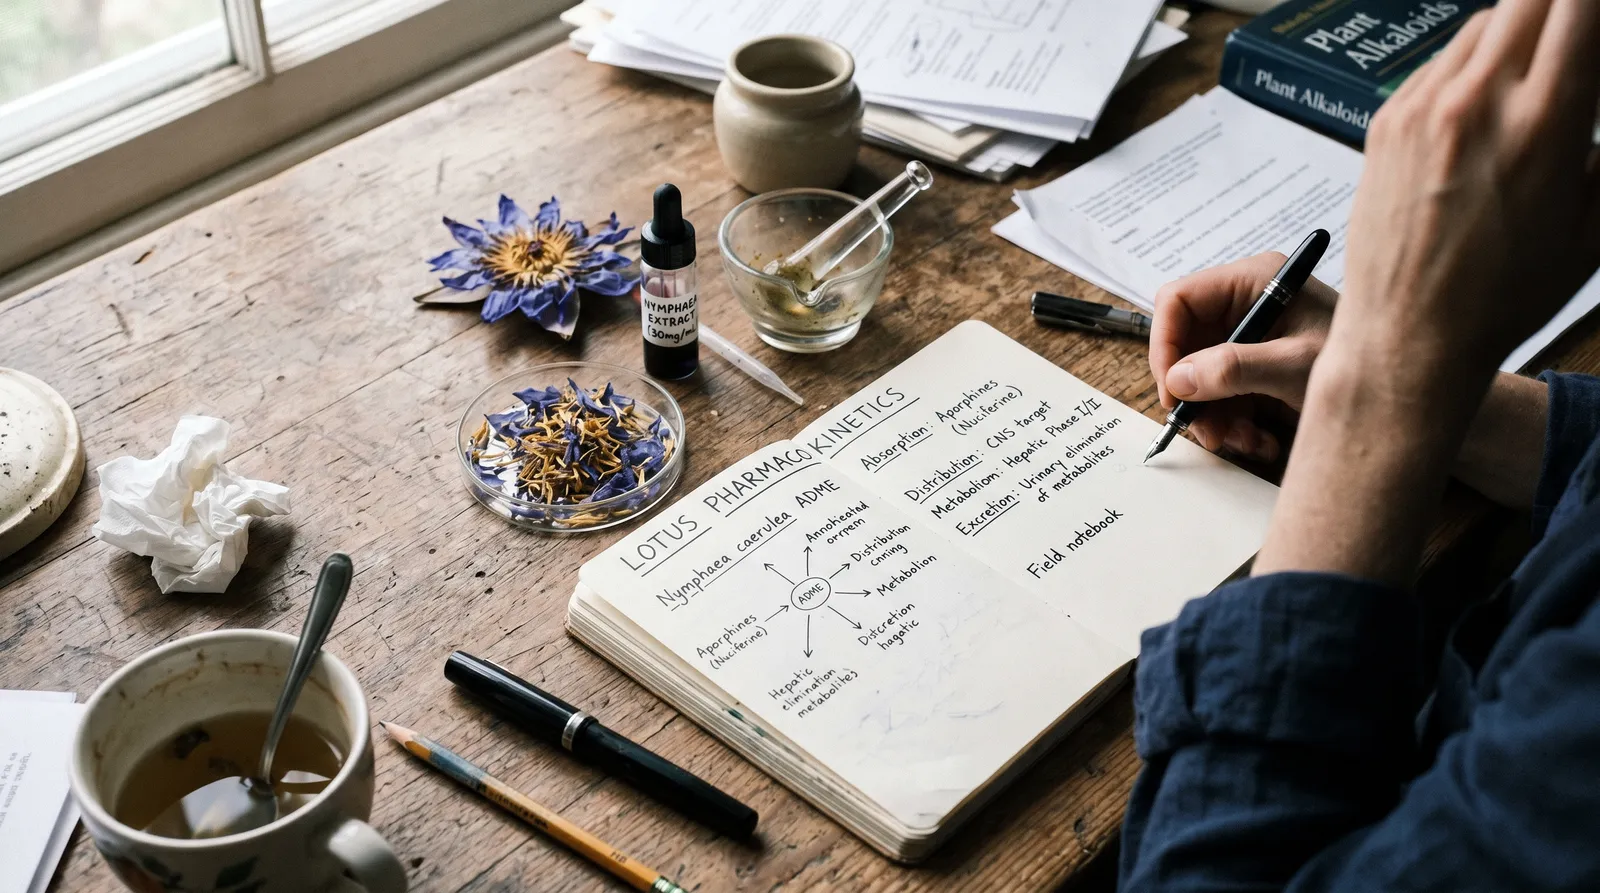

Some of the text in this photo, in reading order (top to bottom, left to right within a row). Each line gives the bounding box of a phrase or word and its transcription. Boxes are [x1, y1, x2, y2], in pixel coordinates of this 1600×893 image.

[1303, 11, 1382, 54] Plant
[1345, 0, 1459, 70] Alkaloids
[1255, 68, 1374, 130] Plant Alkaloid
[648, 309, 695, 327] EXTRACT
[860, 379, 998, 472] Absorption: Aporphines
[951, 385, 1023, 436] (Nuciferine)
[904, 400, 1052, 502] Distribution: CNS target
[1003, 437, 1048, 468] Hepatic
[1045, 413, 1080, 437] Phase
[955, 416, 1122, 536] Excretion: Urinary elimination
[1038, 444, 1115, 503] of metabolites
[619, 514, 698, 572] LOTUS
[655, 479, 841, 608] Nymphaea caerulea ADME
[850, 523, 911, 564] Distribution
[1026, 508, 1124, 579] Field notebook
[798, 583, 825, 606] ADME
[696, 613, 757, 659] Aporphines
[709, 626, 768, 670] (Nuciferine)
[768, 667, 814, 701] Hepatic
[782, 668, 837, 712] elimination
